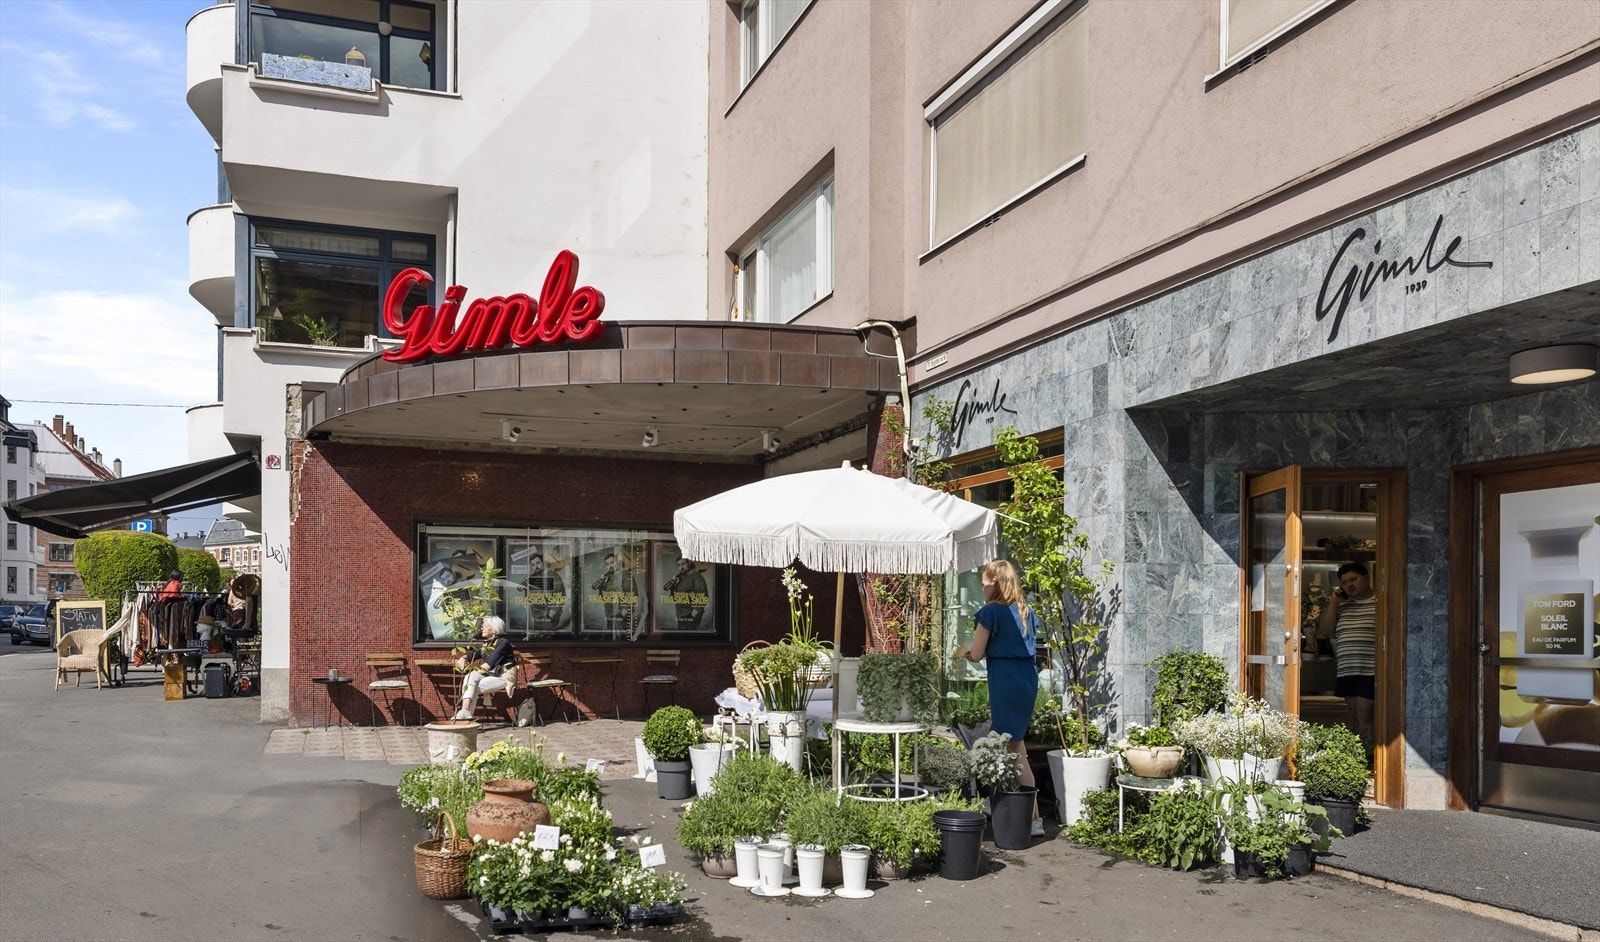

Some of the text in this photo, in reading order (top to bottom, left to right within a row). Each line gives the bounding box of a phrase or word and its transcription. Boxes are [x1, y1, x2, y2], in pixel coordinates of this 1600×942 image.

[1315, 213, 1494, 344] Gimle
[1404, 279, 1428, 296] 1939
[381, 248, 606, 364] Gimle
[950, 378, 1018, 449] Gimle
[136, 521, 147, 532] P
[514, 596, 546, 605] TRASIGA
[588, 594, 620, 604] TRASIGA
[660, 595, 690, 605] TRASIGA
